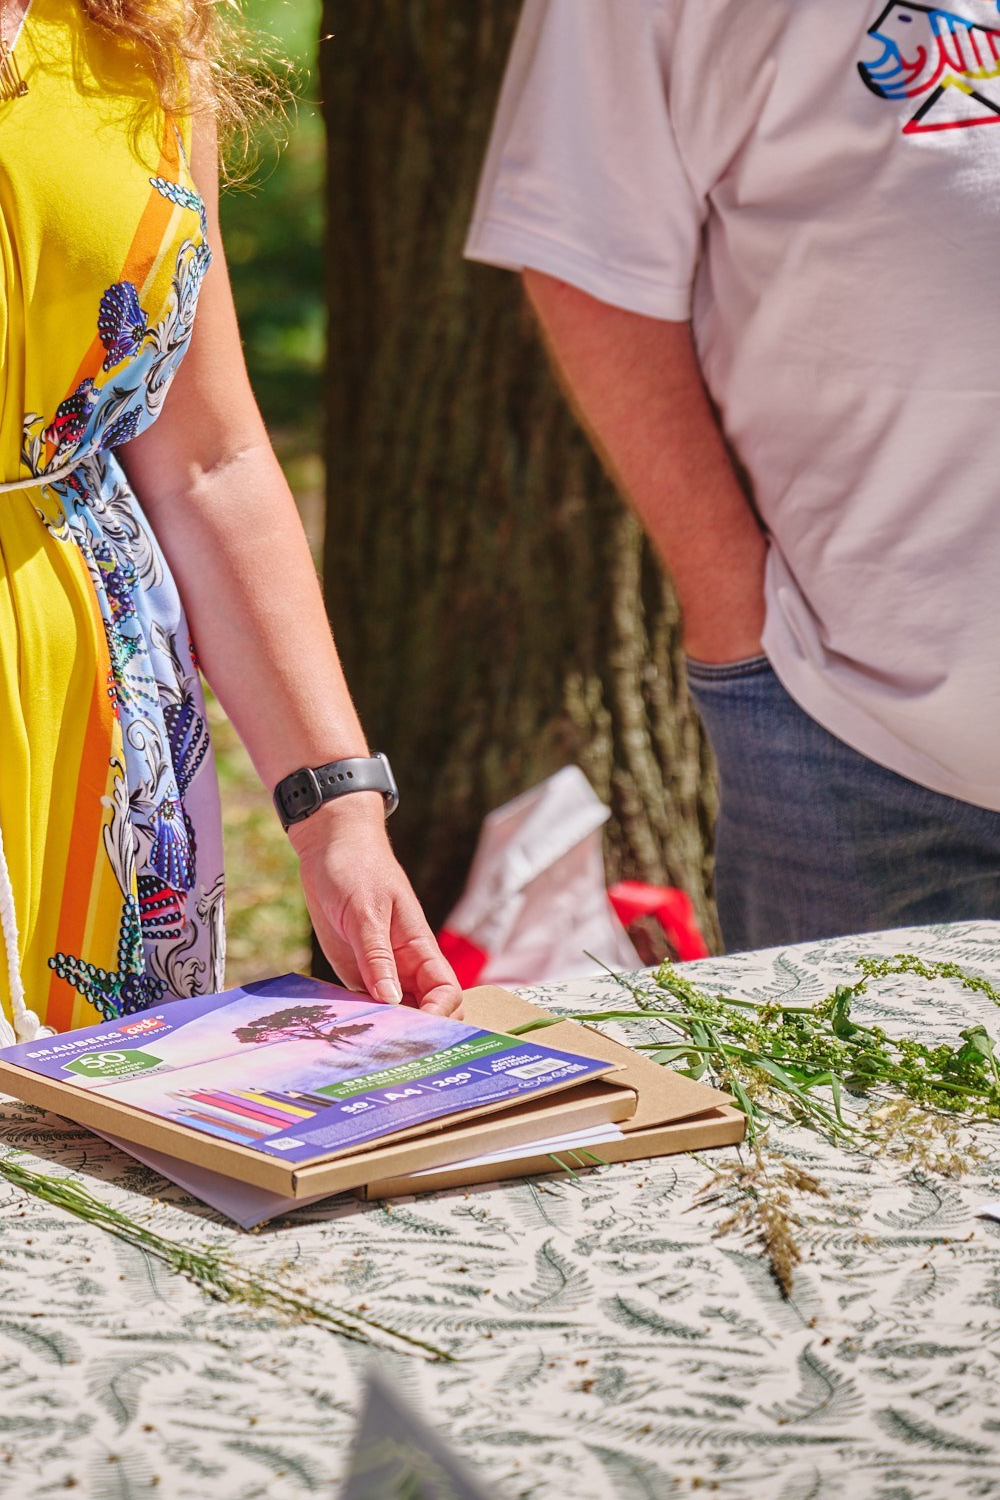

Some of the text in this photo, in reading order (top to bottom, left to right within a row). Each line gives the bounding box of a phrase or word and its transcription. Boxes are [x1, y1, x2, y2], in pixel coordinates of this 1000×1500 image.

[27, 1018, 158, 1058] BRAUBERG art
[39, 1025, 173, 1062] ПРОФЕССИОНАЛЬНАЯ СЕРИЯ
[80, 1053, 126, 1068] 50
[343, 1043, 473, 1086] DRAWING PAPER
[338, 1083, 375, 1095] БУМАГА
[341, 1102, 368, 1113] 50
[432, 1072, 471, 1087] 200
